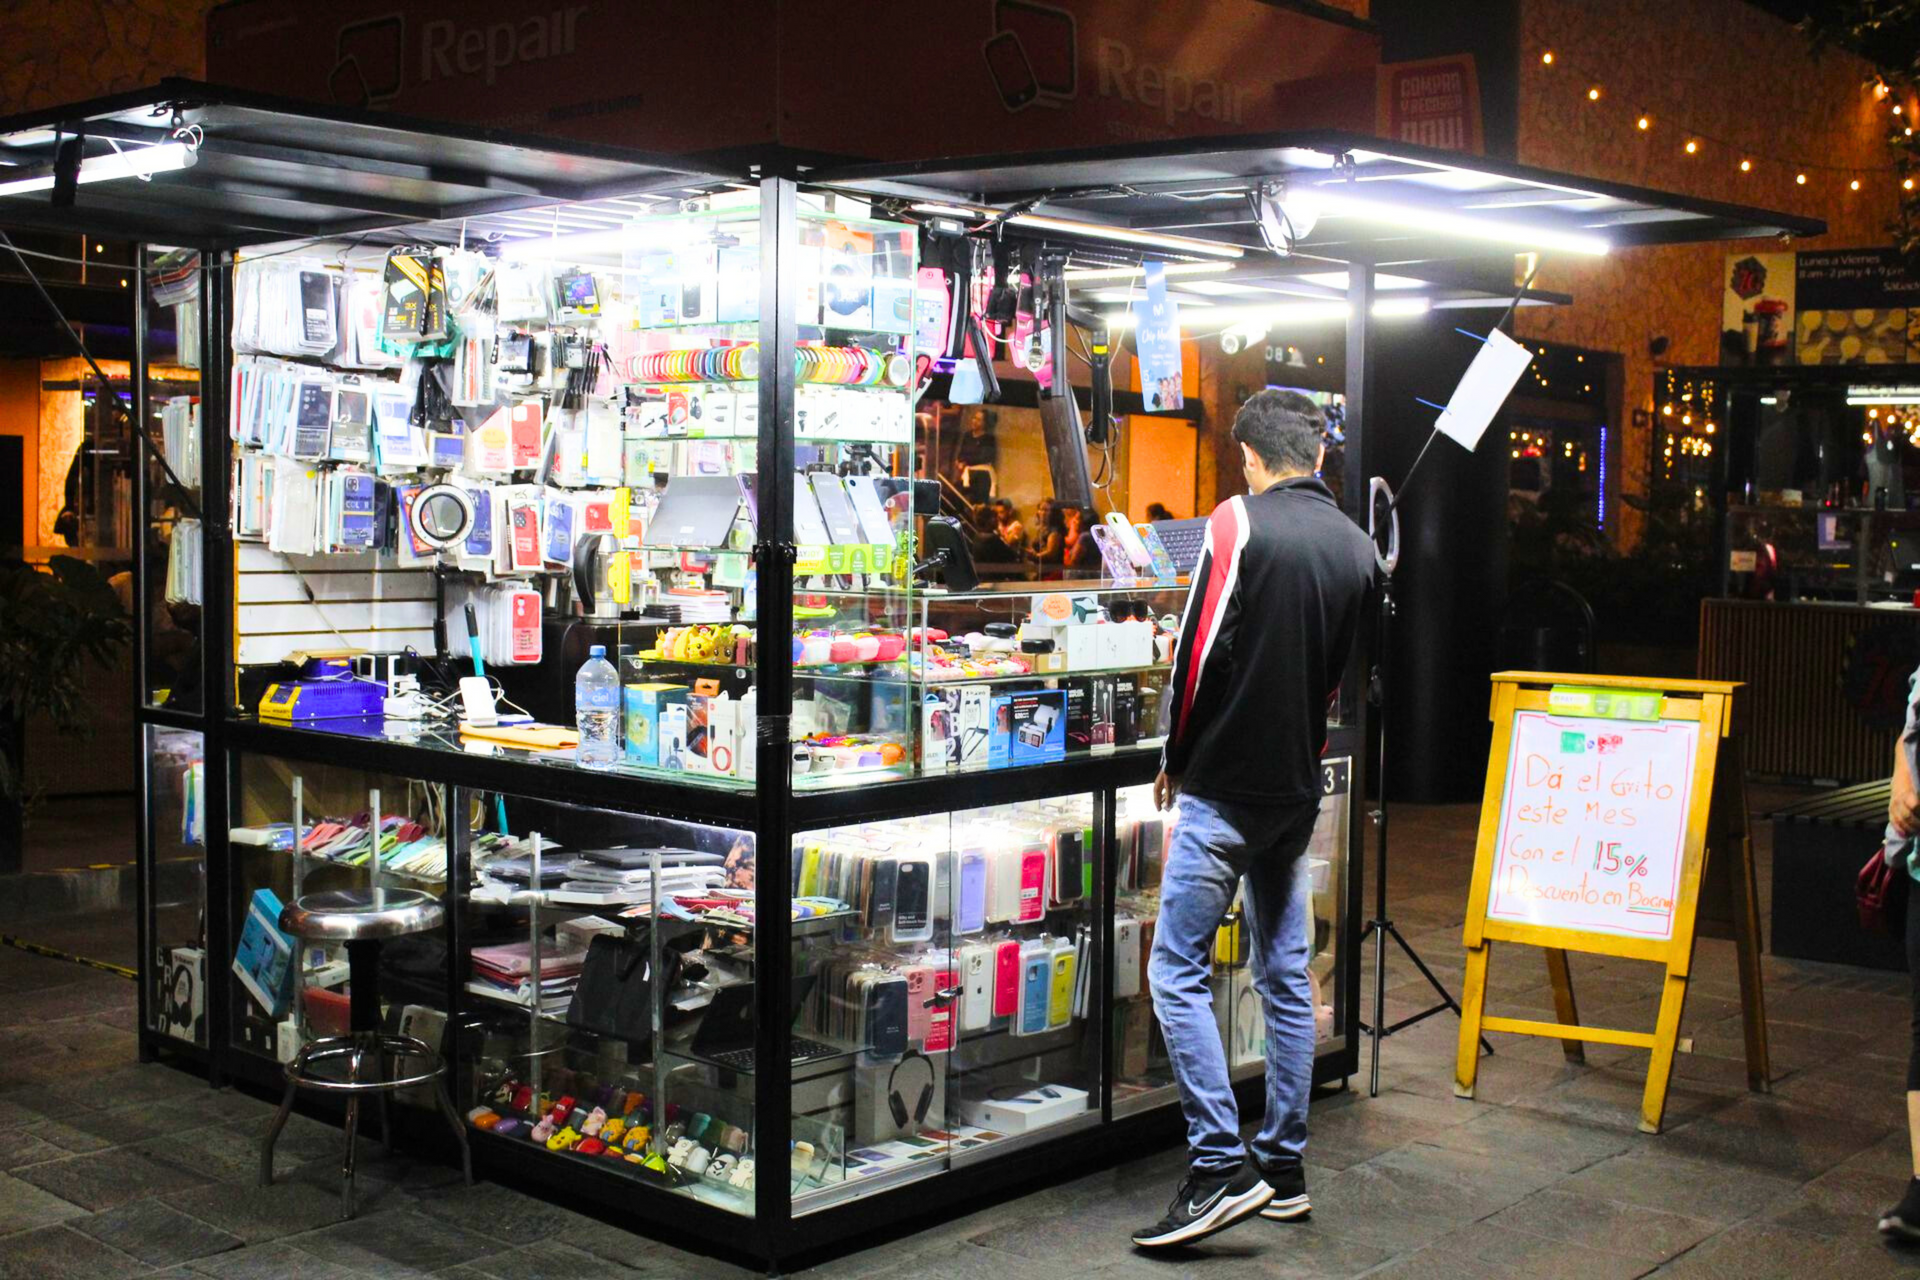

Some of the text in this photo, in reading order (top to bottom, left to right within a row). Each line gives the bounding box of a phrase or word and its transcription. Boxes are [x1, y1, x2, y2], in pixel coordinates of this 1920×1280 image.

[420, 6, 592, 86] Repair
[1098, 36, 1250, 127] Repair
[1799, 254, 1880, 267] Lunes a Viernes
[796, 550, 820, 558] AYJOY
[592, 692, 609, 702] ciel
[1526, 754, 1674, 800] Dá el Grito
[1517, 795, 1637, 827] este Mes
[1509, 834, 1648, 878] Con el 15%
[1506, 864, 1599, 906] Descuento
[1604, 888, 1622, 906] en
